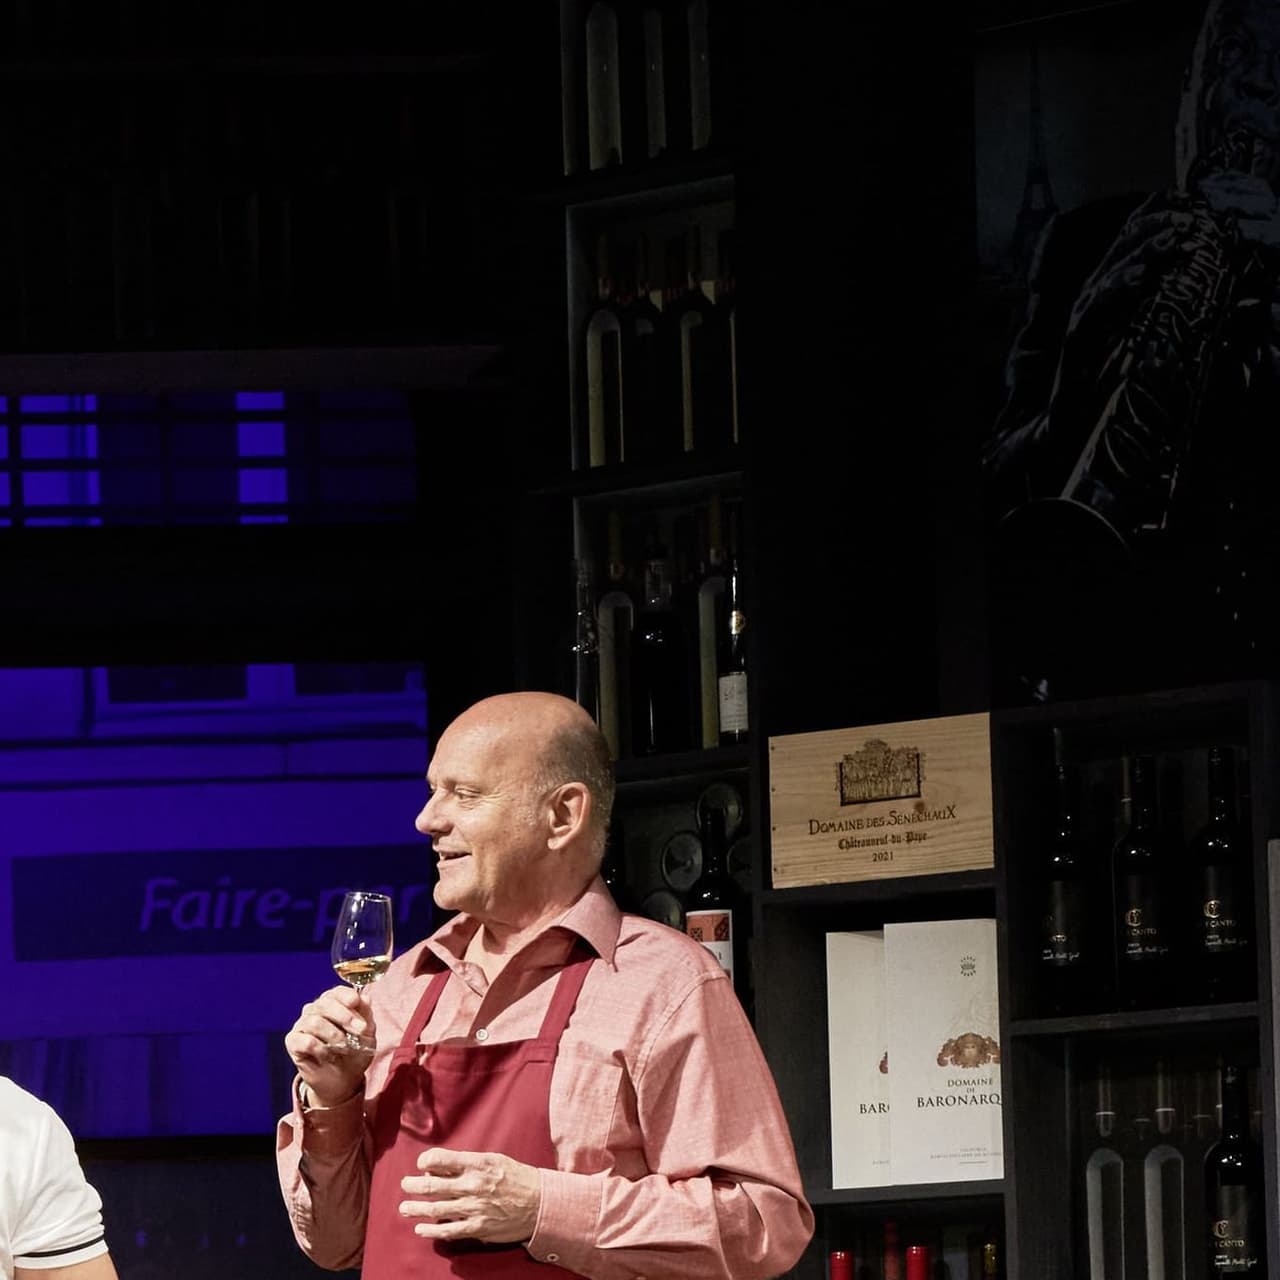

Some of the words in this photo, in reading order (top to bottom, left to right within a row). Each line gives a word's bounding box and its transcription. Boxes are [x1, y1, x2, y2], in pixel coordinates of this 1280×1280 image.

[866, 816, 885, 828] DES
[872, 852, 894, 862] 2021
[947, 1077, 993, 1088] DOMAINE
[917, 1092, 1003, 1109] BARONARQ
